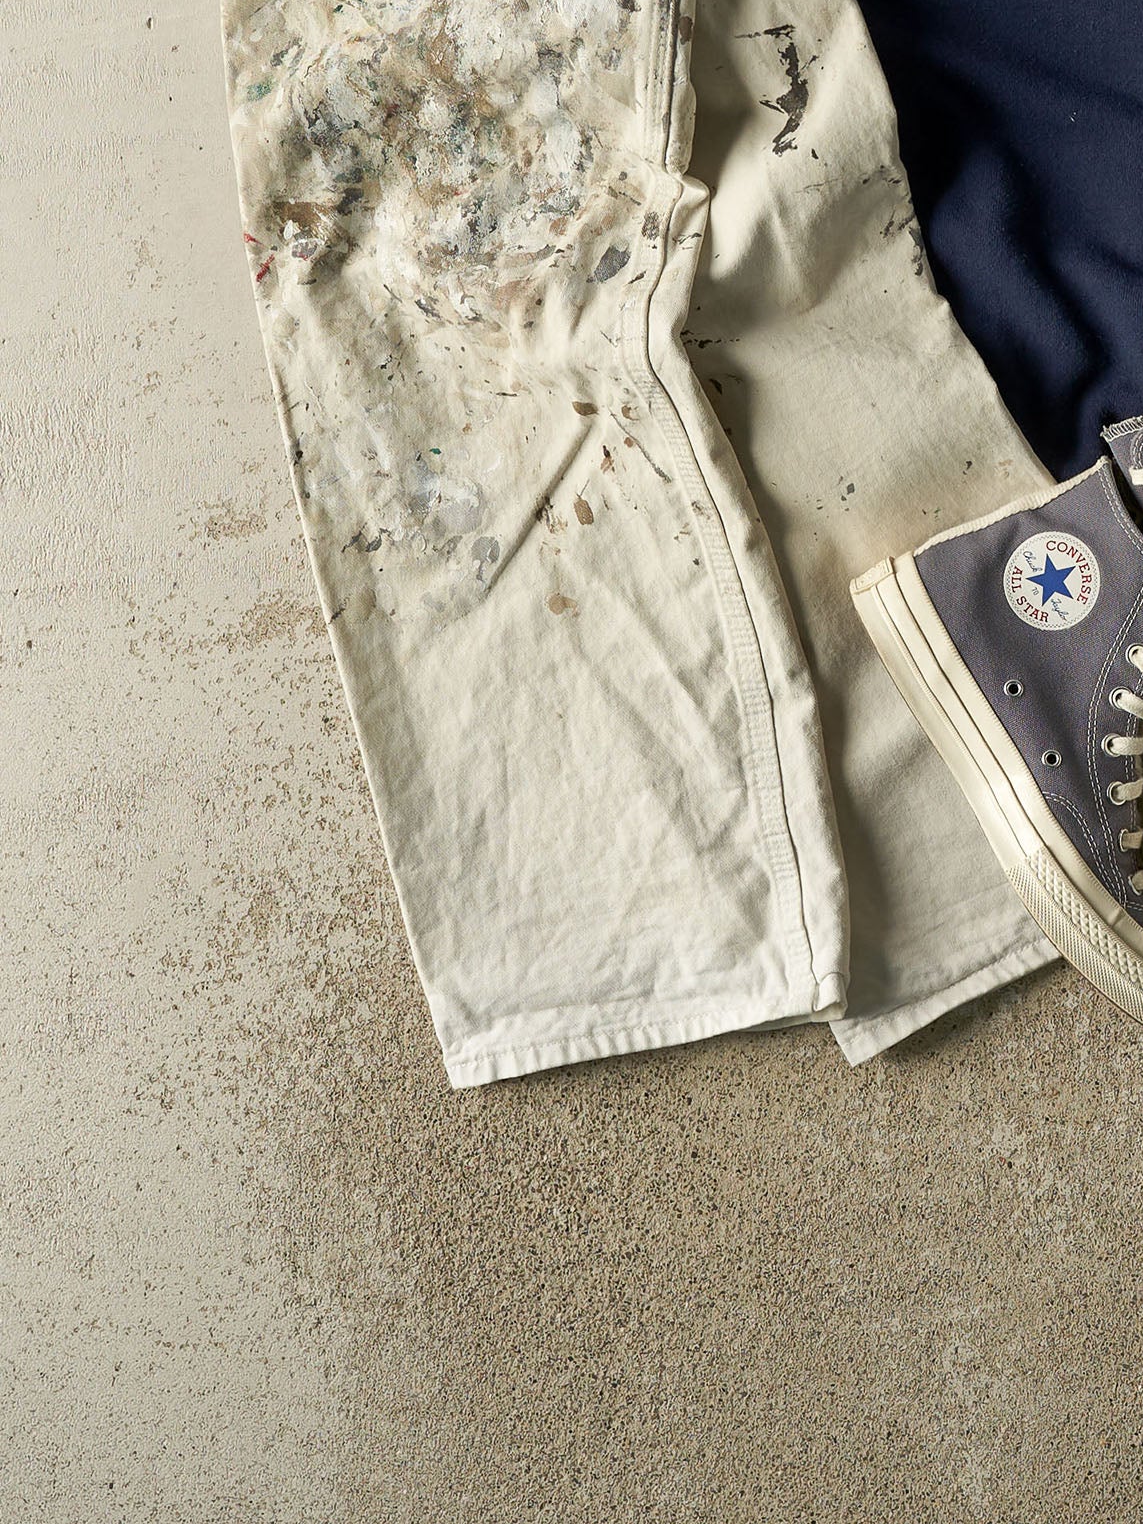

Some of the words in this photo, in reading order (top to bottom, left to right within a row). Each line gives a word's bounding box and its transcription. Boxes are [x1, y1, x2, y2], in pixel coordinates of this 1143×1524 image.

[1011, 566, 1023, 593] ALL
[1046, 540, 1093, 605] CONVERSE
[1016, 595, 1049, 623] STAR
